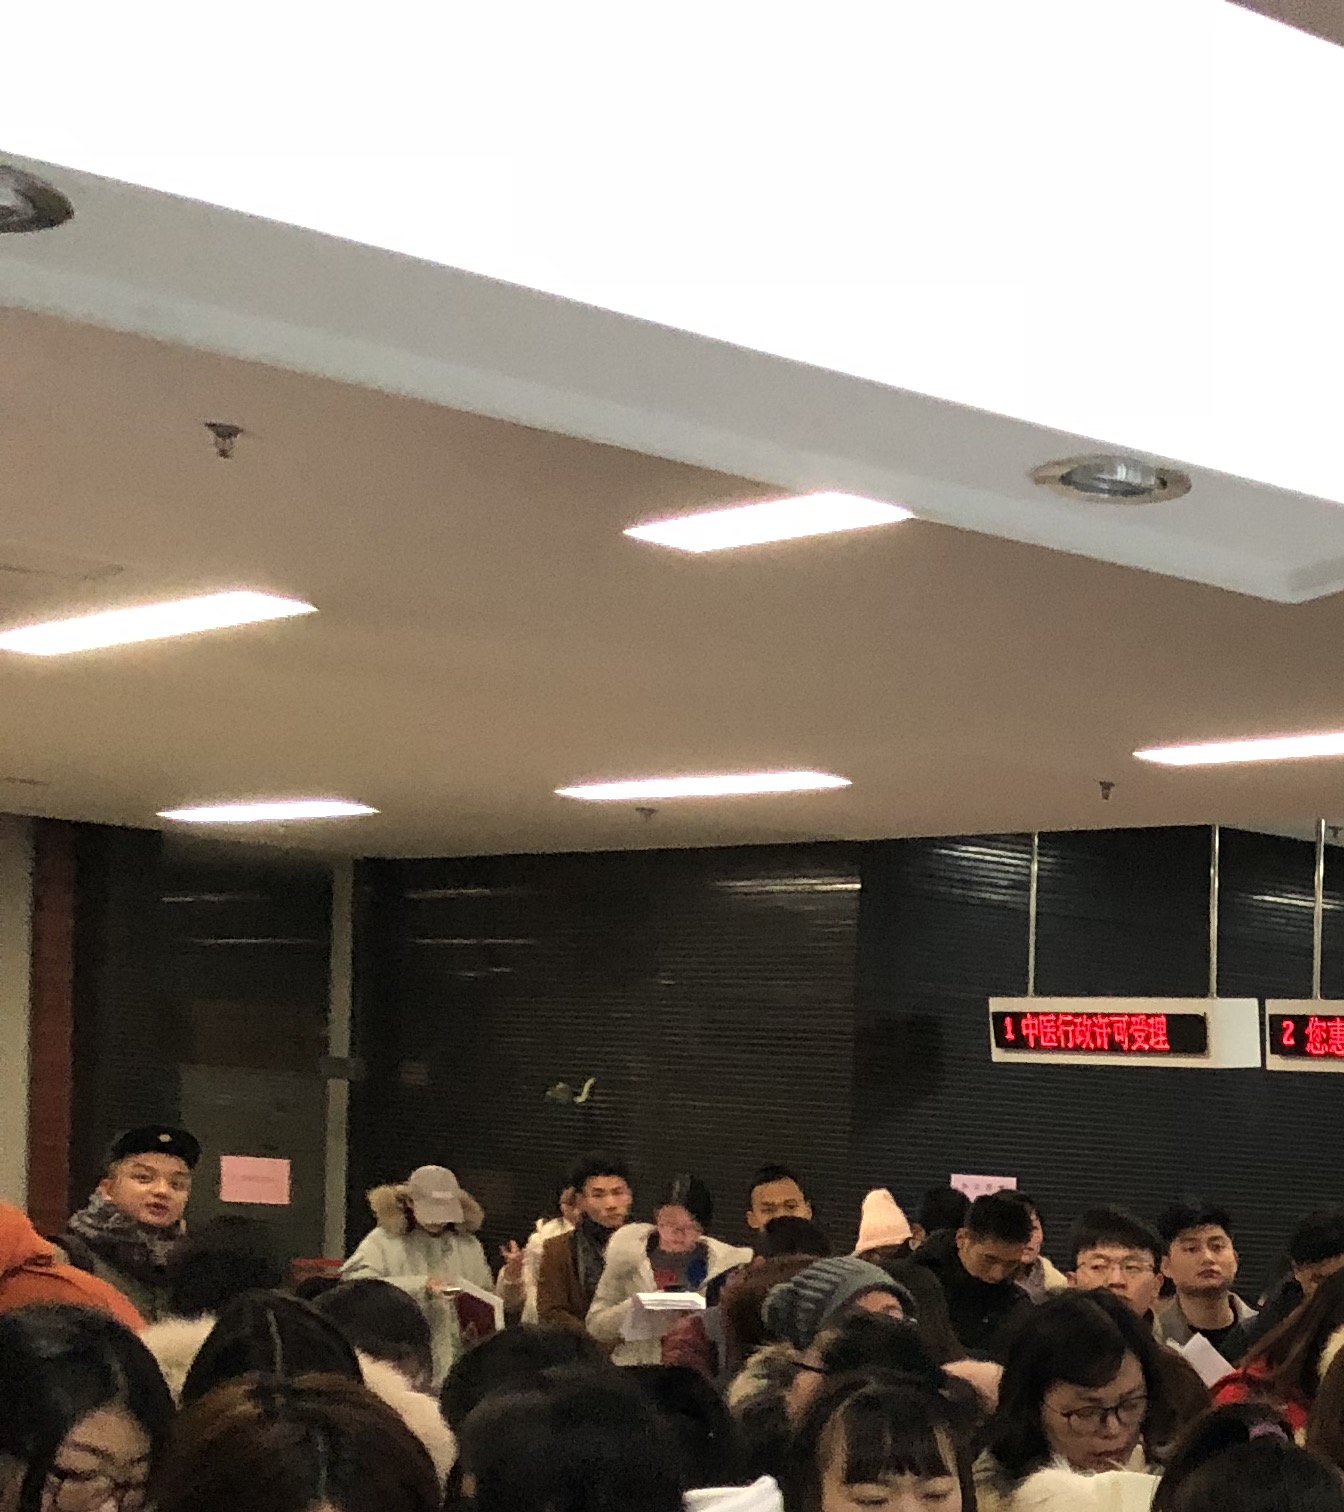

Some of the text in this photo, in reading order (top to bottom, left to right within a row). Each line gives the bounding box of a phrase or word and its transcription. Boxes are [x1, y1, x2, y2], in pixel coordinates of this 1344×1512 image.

[1004, 1013, 1170, 1050] 1 中医行政许可受理
[1282, 1020, 1295, 1046] 2
